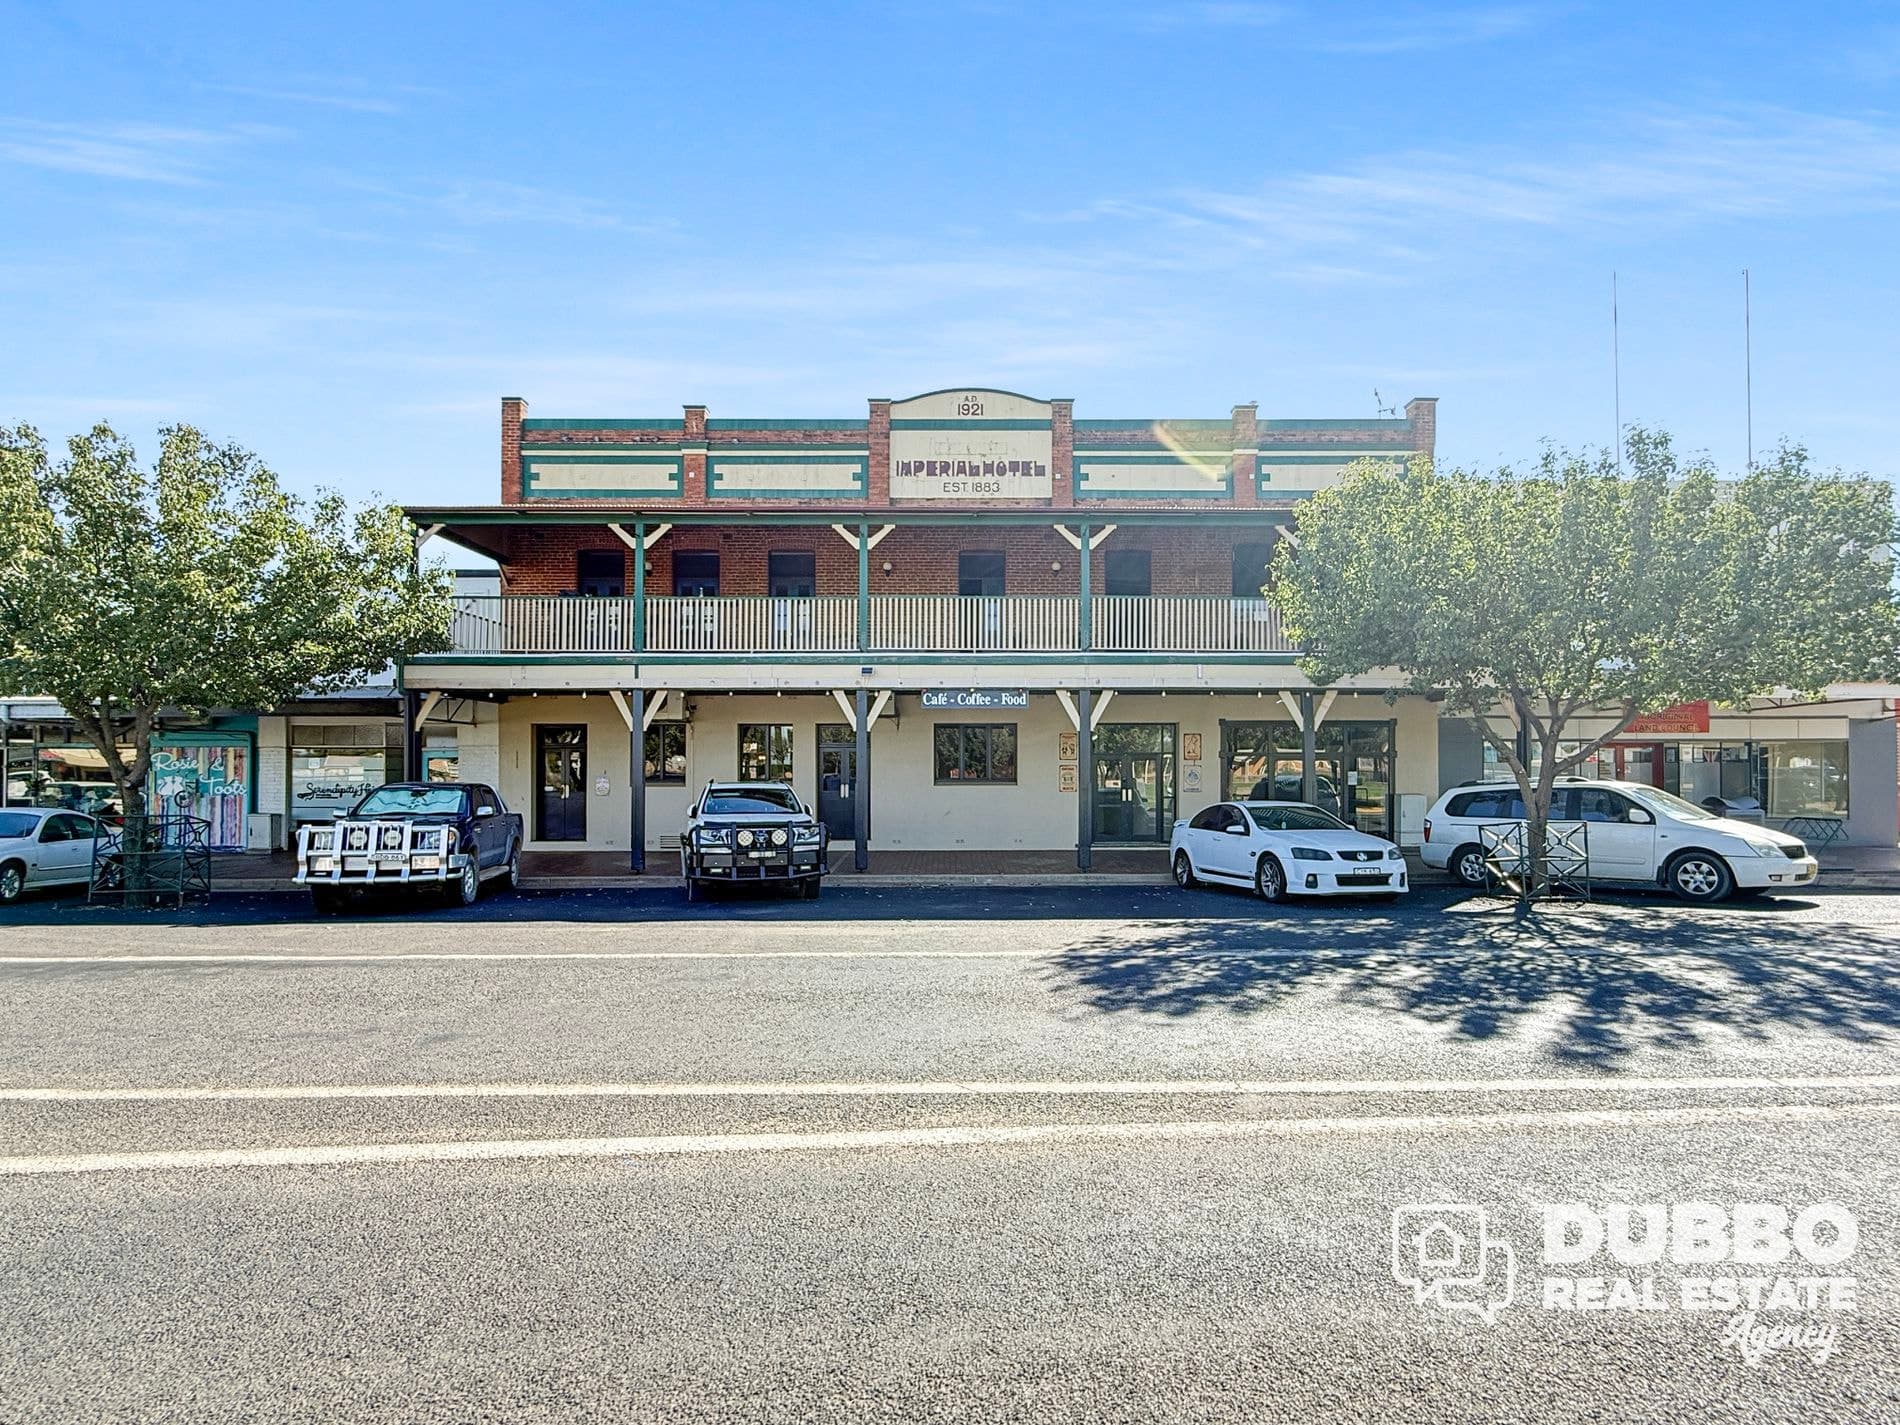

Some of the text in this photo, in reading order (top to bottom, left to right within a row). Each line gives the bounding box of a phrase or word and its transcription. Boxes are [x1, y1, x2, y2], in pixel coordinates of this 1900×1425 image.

[957, 403, 984, 416] 1921
[896, 460, 1046, 477] IMPERIAL HOTEL
[971, 482, 1000, 493] 1883
[922, 692, 948, 705] Café
[957, 692, 991, 705] Coffee
[1001, 692, 1026, 705] Food
[1634, 723, 1659, 732] LAND
[151, 752, 225, 771] Rosie &
[199, 773, 247, 796] Toots
[299, 782, 361, 799] Serendipity
